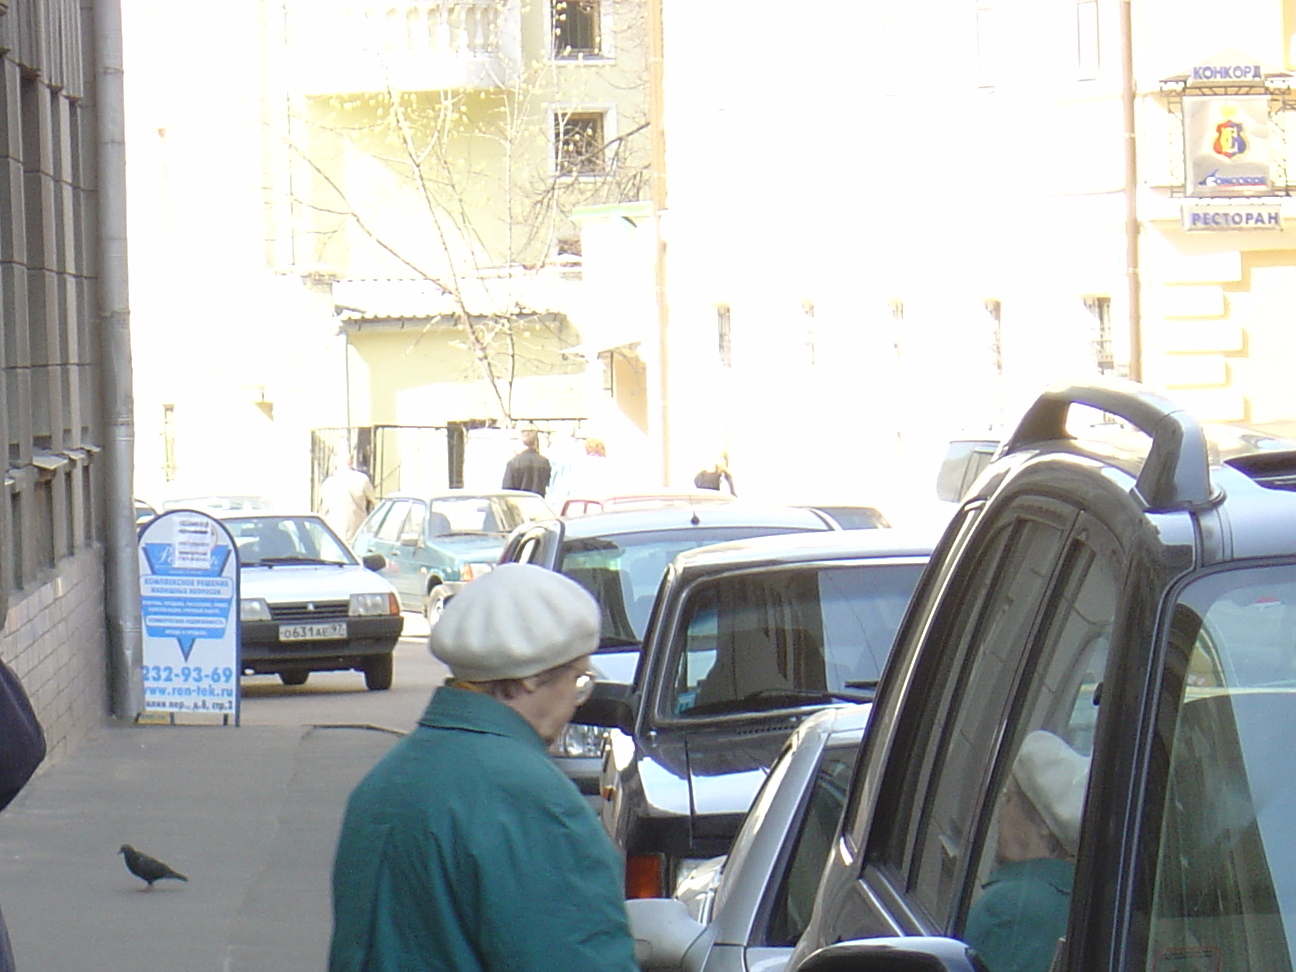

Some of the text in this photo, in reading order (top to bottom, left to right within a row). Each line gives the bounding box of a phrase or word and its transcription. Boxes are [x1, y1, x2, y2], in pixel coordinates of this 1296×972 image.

[1193, 65, 1262, 80] КОНКОРД
[1191, 212, 1279, 226] РЕСТОРАН
[142, 665, 233, 683] 232-93-69
